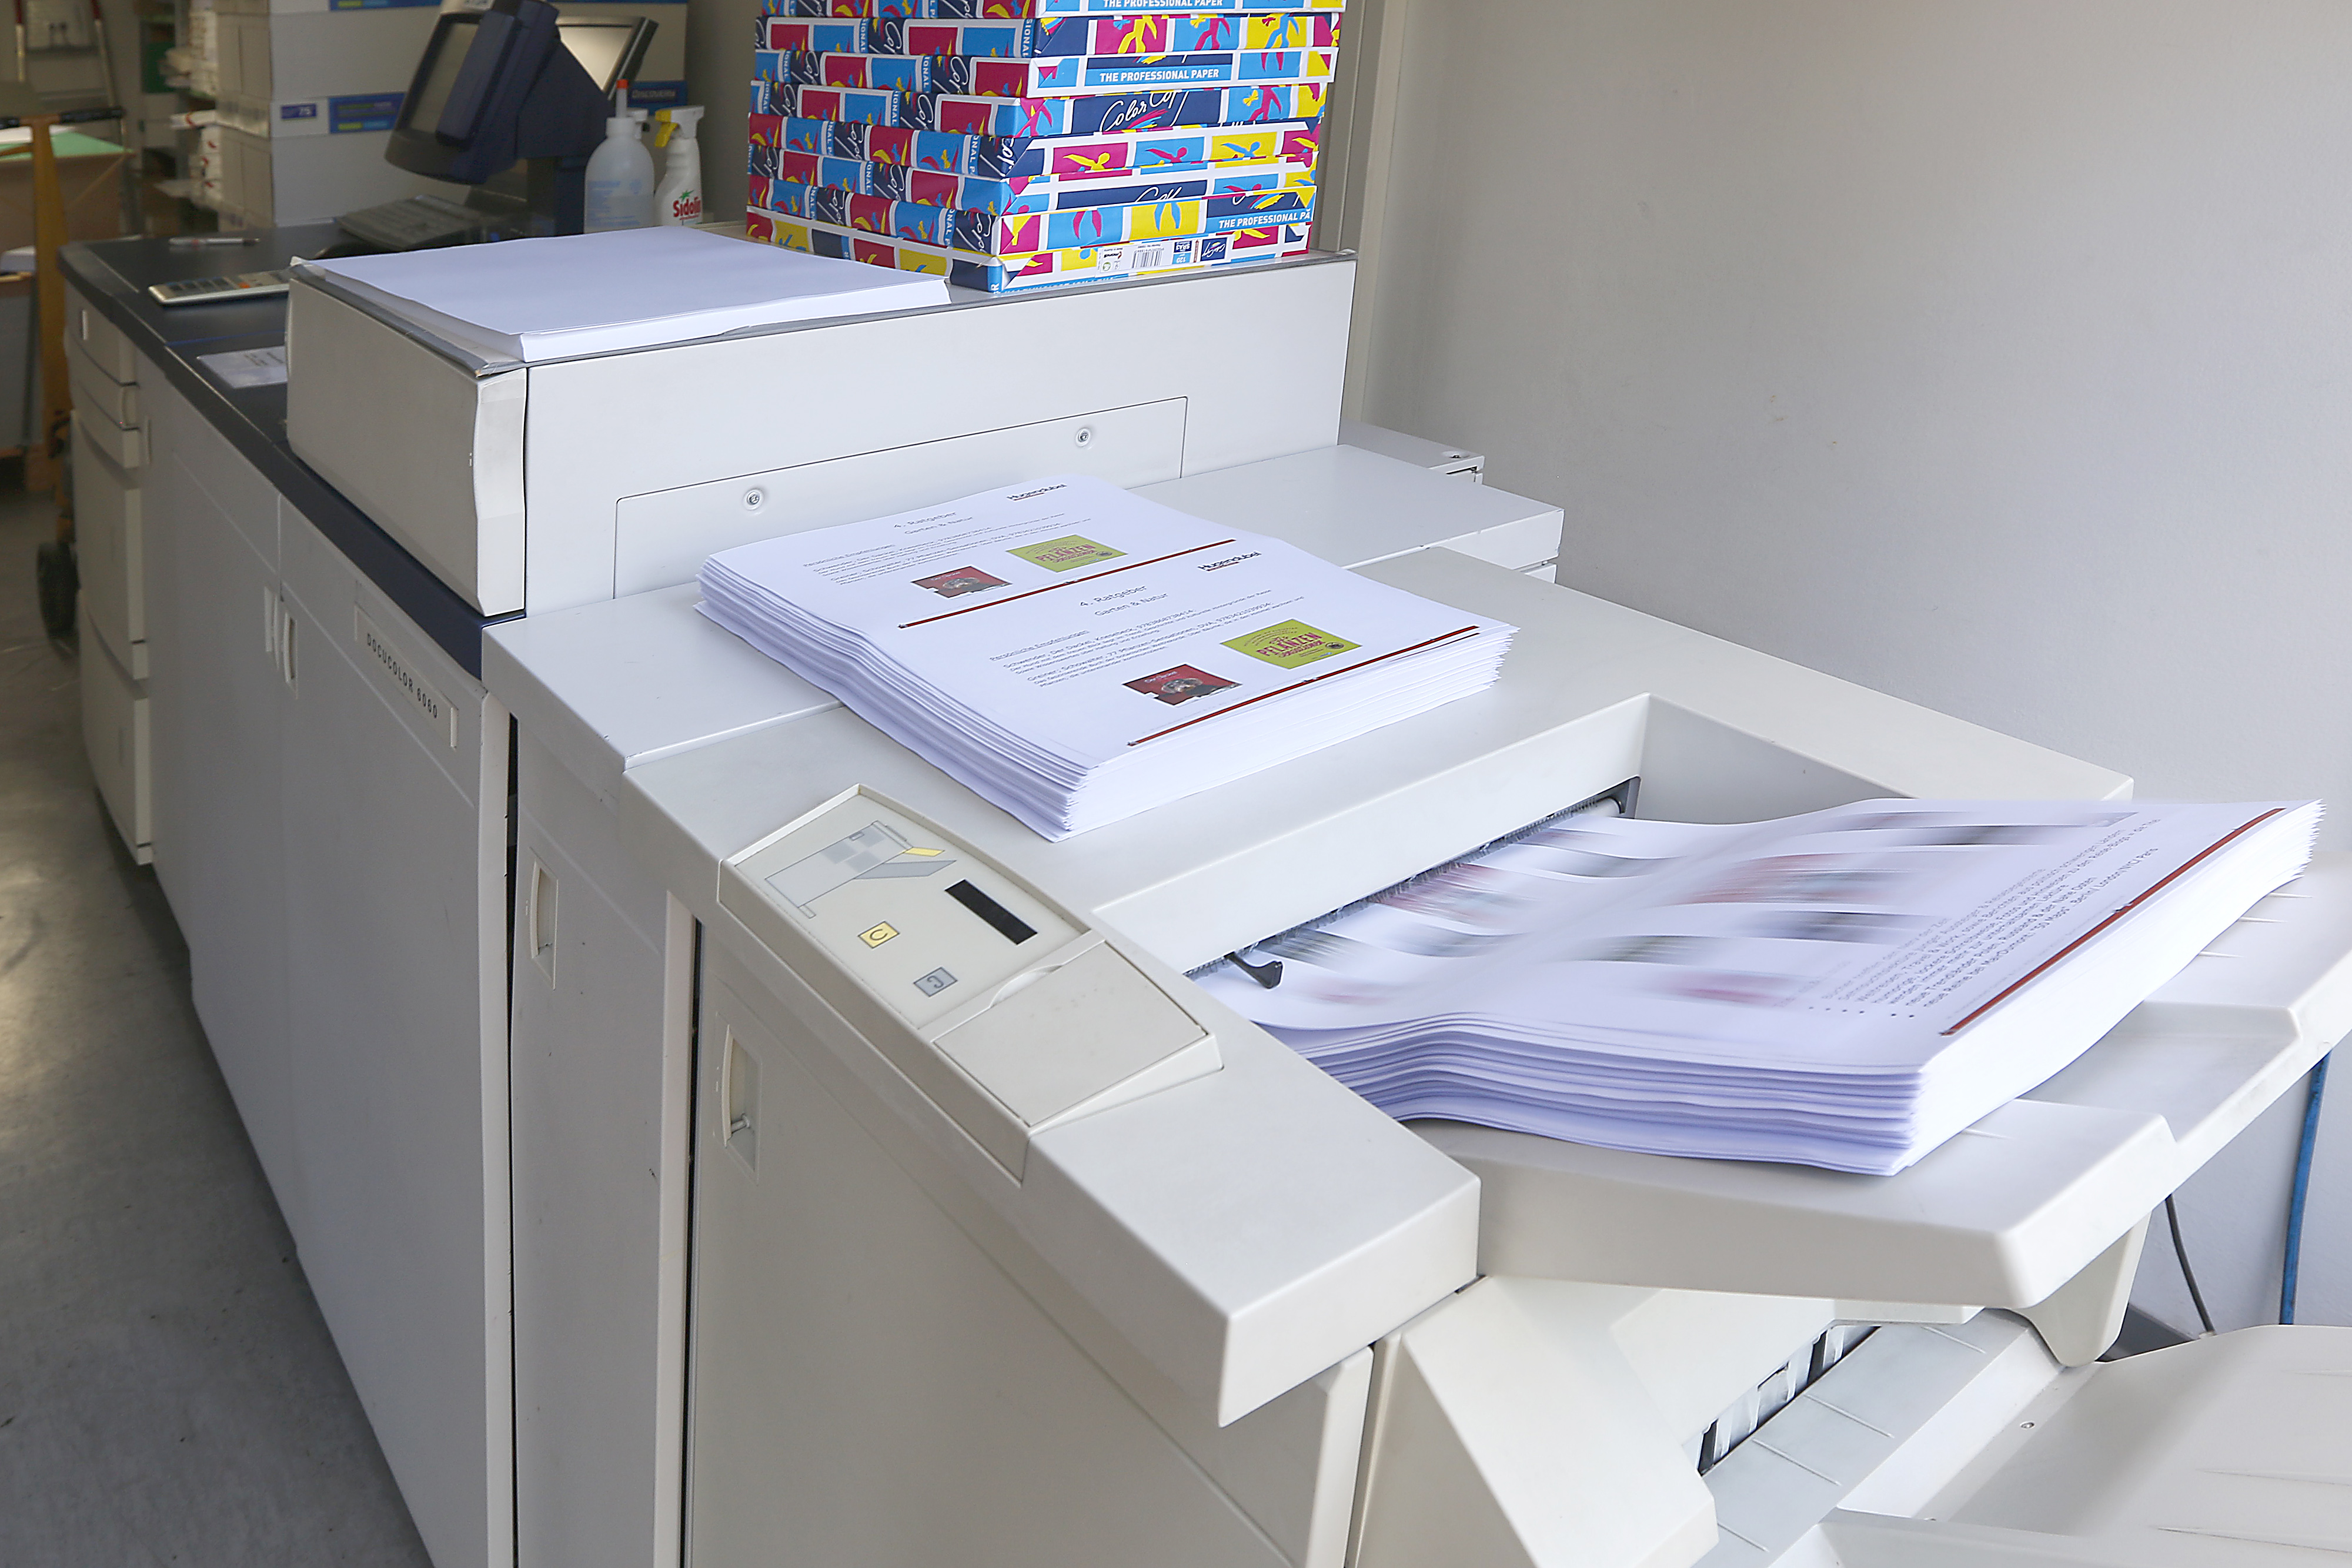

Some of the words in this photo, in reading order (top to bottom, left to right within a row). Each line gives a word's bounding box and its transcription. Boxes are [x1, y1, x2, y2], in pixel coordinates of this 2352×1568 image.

[1100, 72, 1118, 82] THE
[1121, 71, 1189, 81] PROFESSIONAL
[1191, 69, 1219, 79] PAPER
[1218, 218, 1235, 229] THE
[1238, 213, 1298, 228] PROFESSIONAL
[1198, 551, 1262, 570] Hugendubel
[1094, 585, 1147, 603] Ratgeber
[1094, 603, 1130, 617] Garten
[1140, 593, 1168, 604] Natur
[1256, 632, 1322, 656] PFLANZEN
[367, 633, 413, 693] DOCUCOLOR
